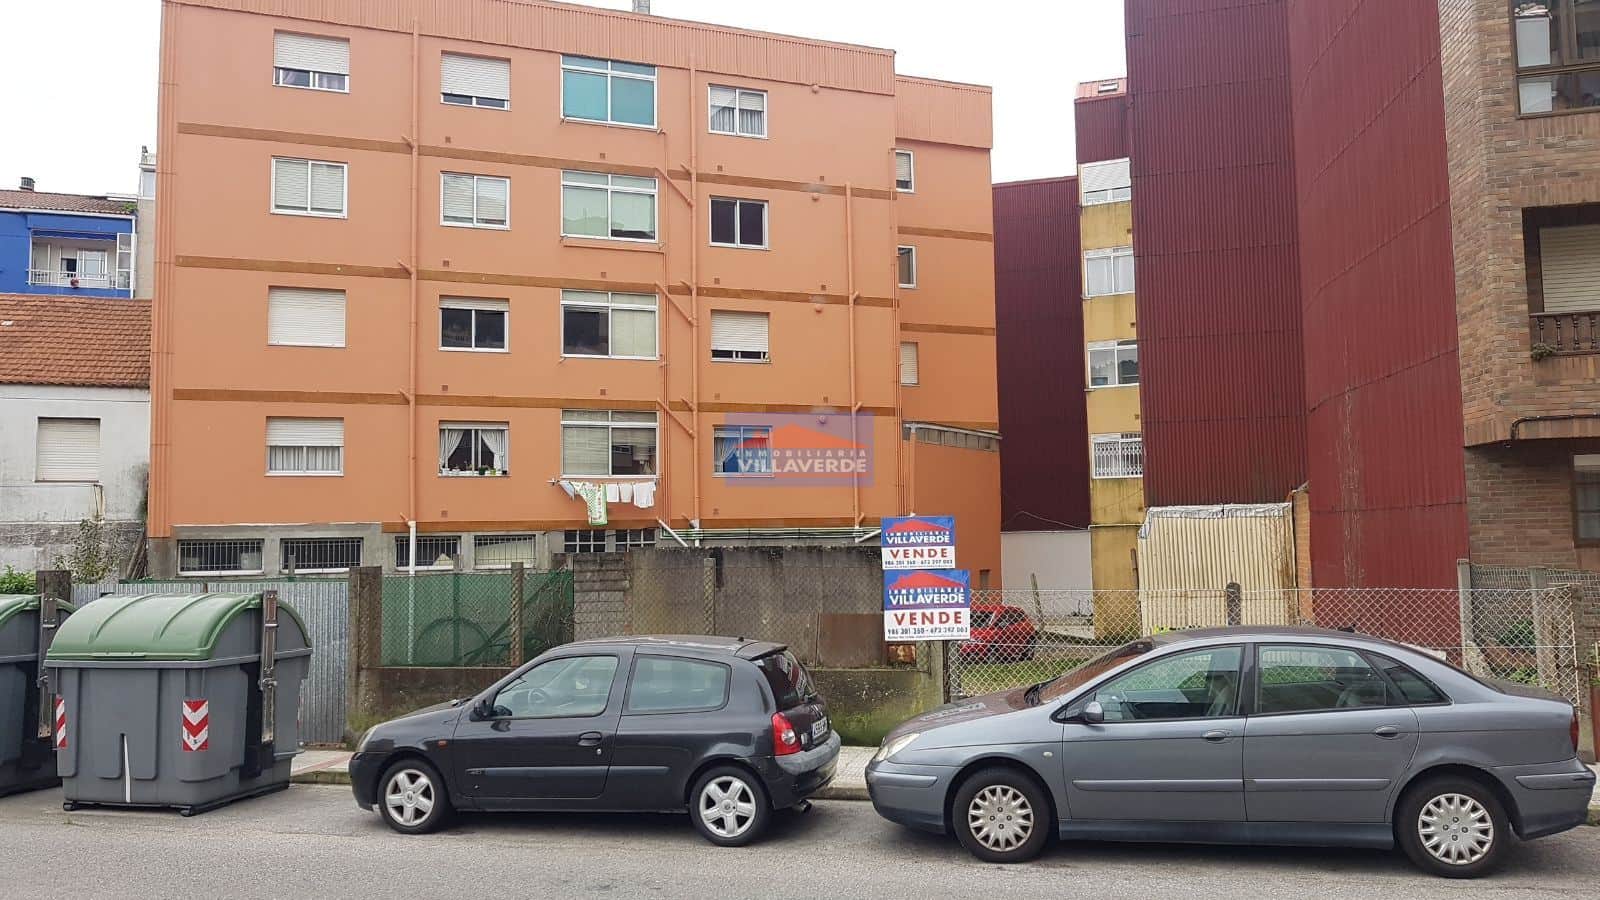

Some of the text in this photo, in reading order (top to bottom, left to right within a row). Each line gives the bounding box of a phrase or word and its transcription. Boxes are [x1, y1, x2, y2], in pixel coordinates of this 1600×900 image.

[886, 535, 950, 544] VILLAVERDE
[889, 548, 948, 559] VENDE
[889, 593, 965, 606] VILLAVERDE
[893, 611, 962, 626] VENDE
